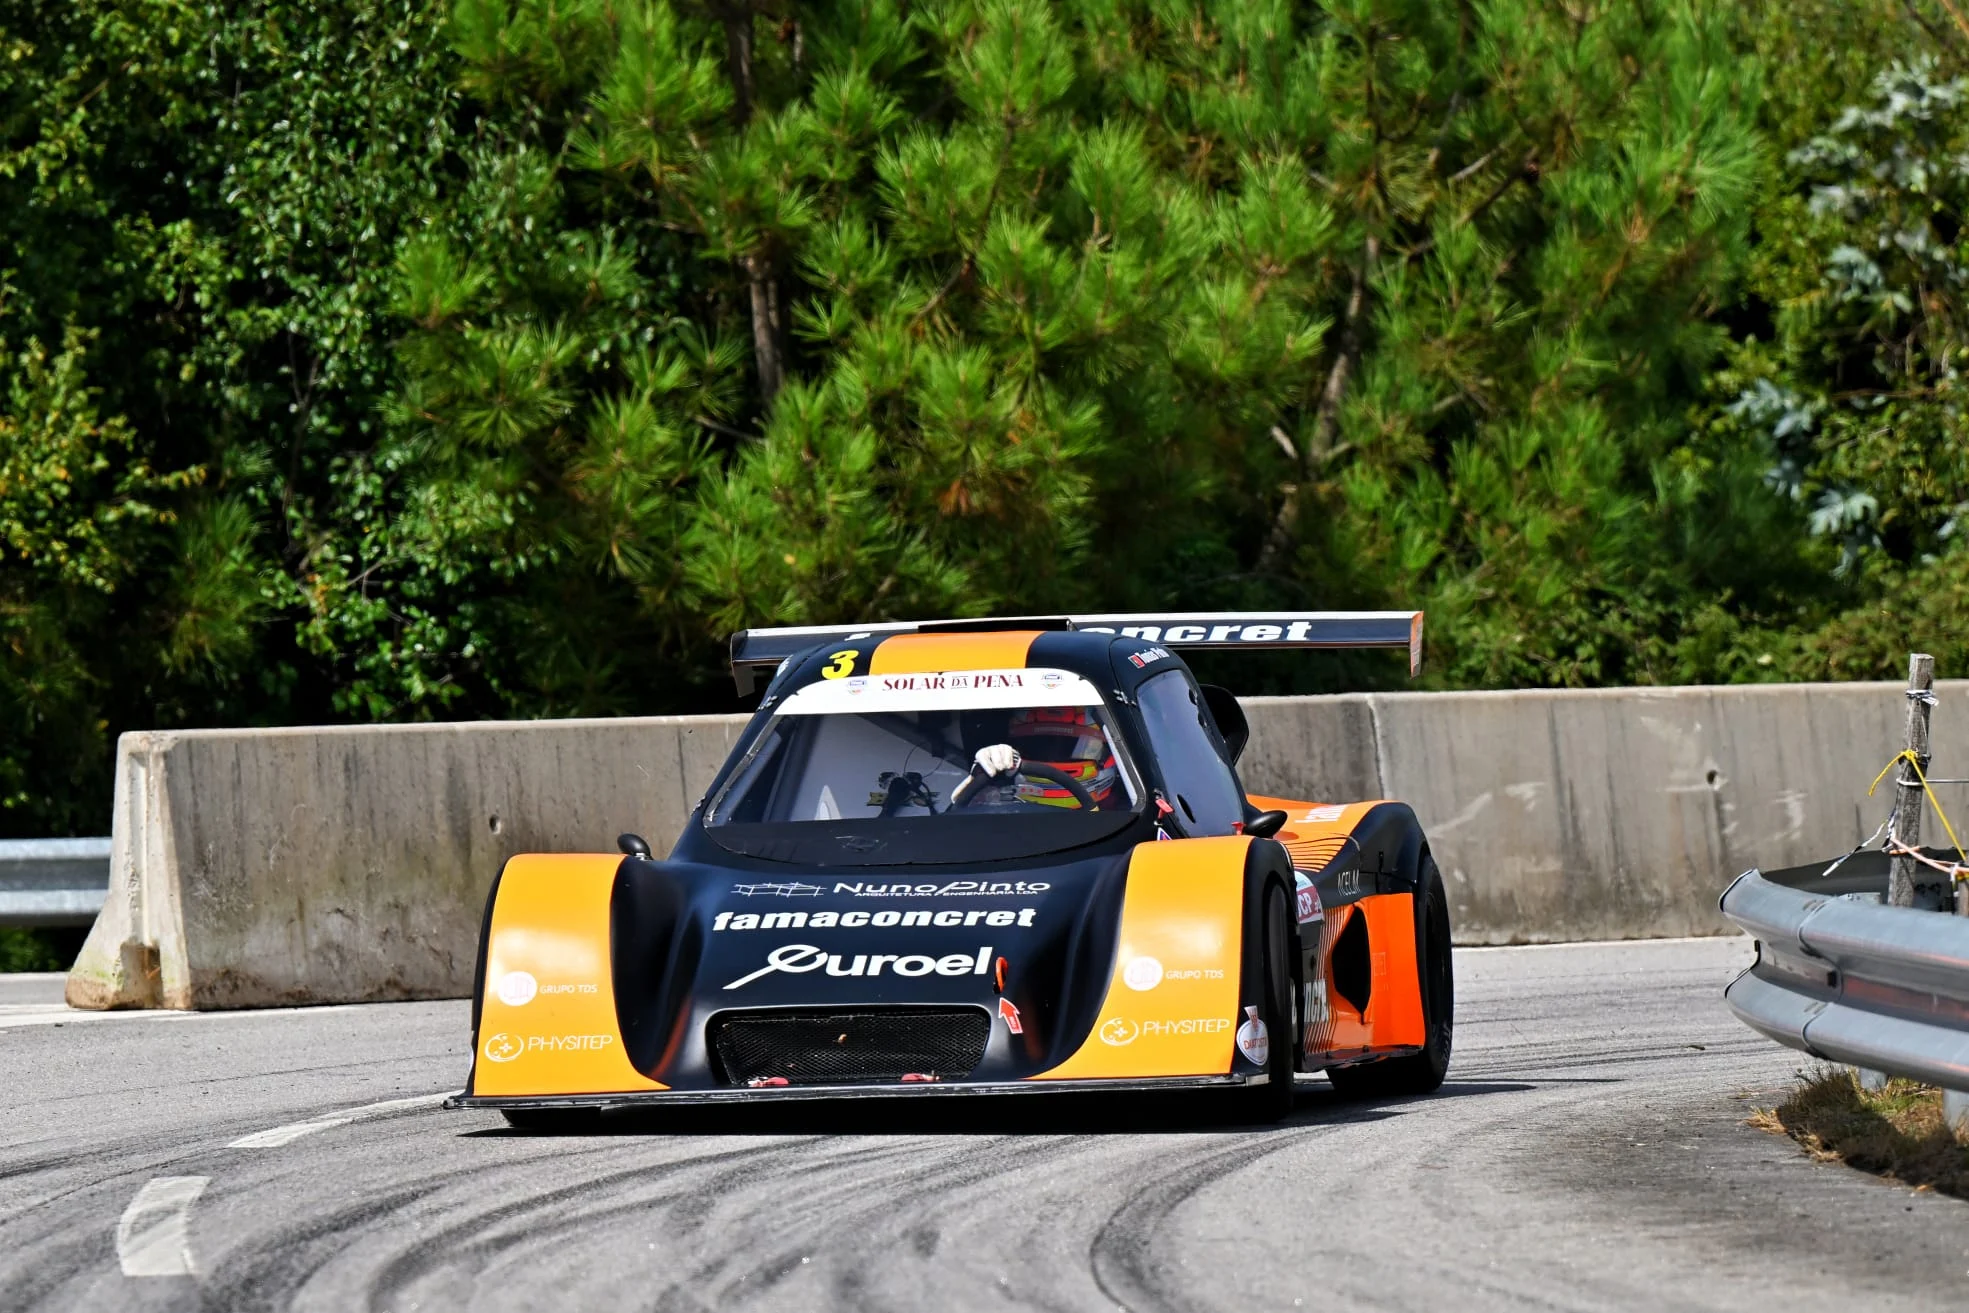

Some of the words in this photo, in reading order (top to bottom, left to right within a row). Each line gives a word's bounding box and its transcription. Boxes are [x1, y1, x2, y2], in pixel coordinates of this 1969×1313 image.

[821, 650, 860, 680] 3
[882, 677, 946, 692] SOLAR
[951, 675, 969, 690] DA
[973, 674, 1024, 689] PENA
[713, 908, 1036, 931] famaconcret
[722, 944, 993, 990] euroel
[1166, 970, 1201, 980] GRUPO
[1204, 969, 1225, 979] TDS
[540, 984, 575, 994] GRUPO
[578, 984, 598, 993] TDS
[1143, 1018, 1231, 1036] PHYSITEP
[527, 1034, 613, 1051] PHYSITEP
